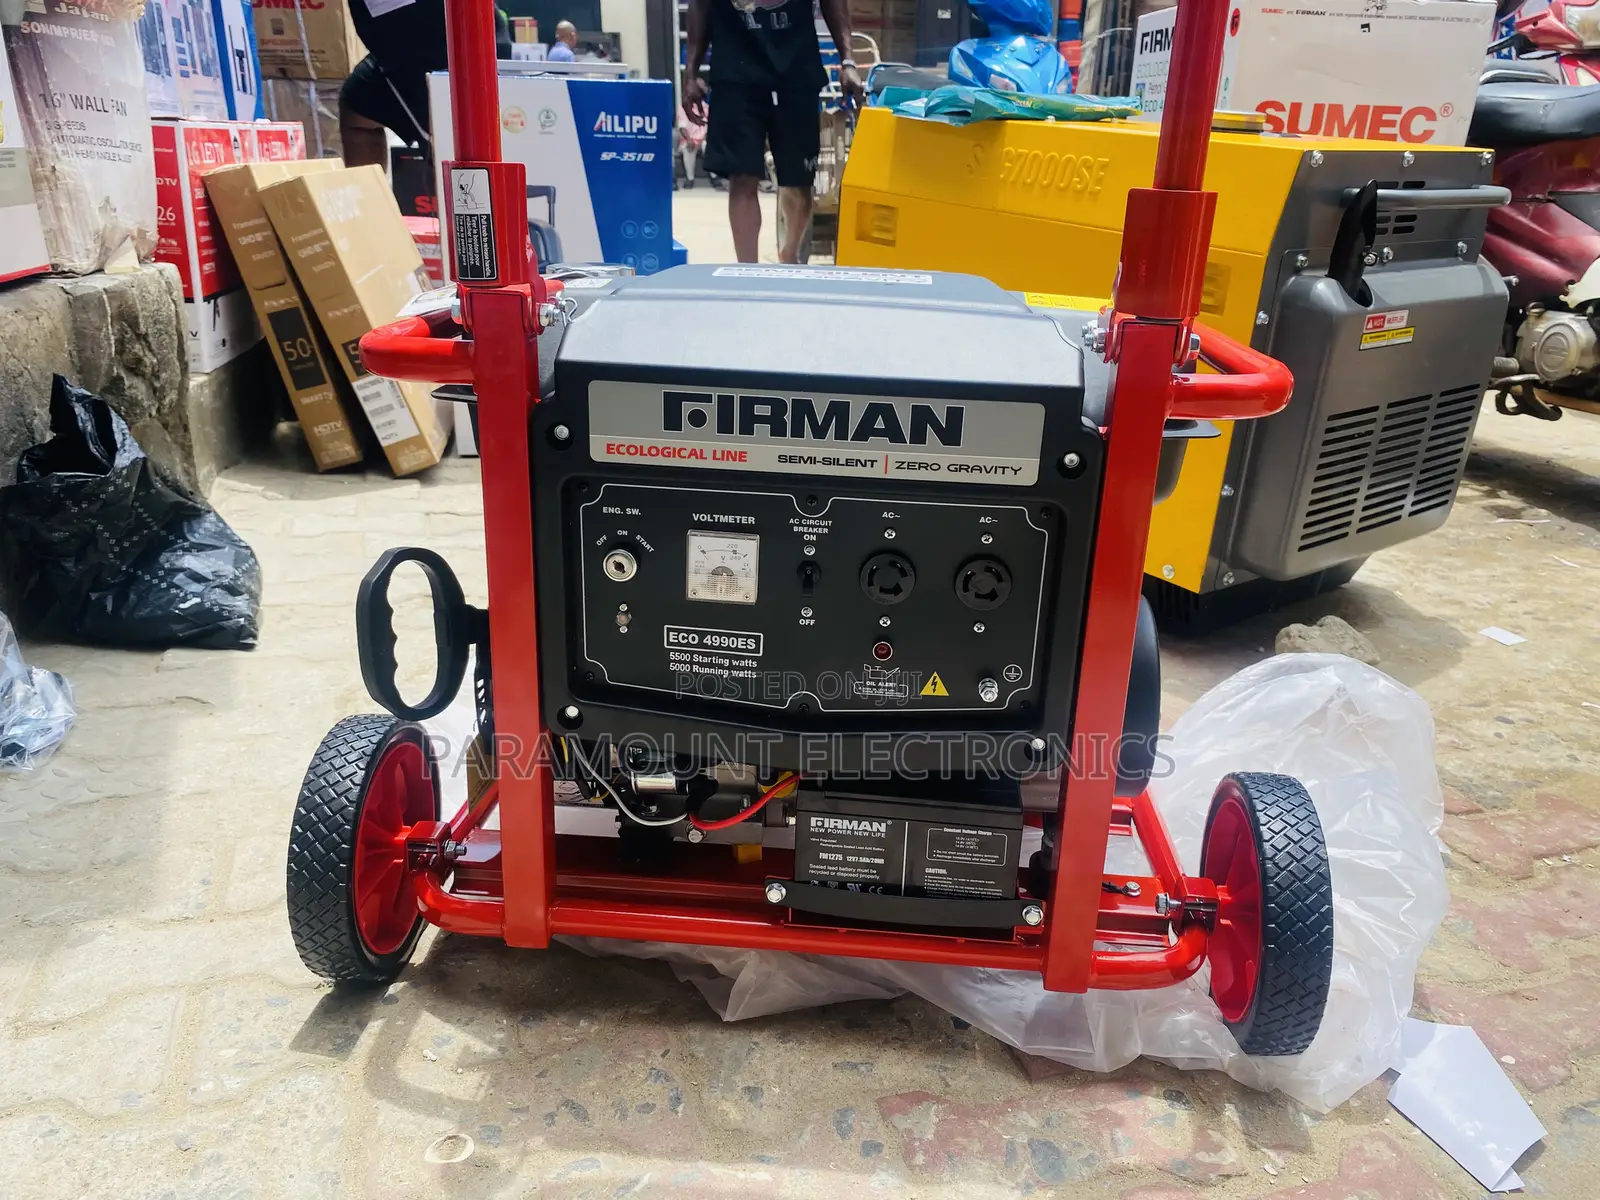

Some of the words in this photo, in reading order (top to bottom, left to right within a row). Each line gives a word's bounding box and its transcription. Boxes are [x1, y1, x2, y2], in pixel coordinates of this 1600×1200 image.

[69, 93, 109, 113] WALL
[593, 111, 658, 134] AILIPU
[283, 338, 310, 361] 50
[660, 388, 966, 449] FIRMAN
[606, 442, 708, 461] ECOLOGICAL
[712, 447, 748, 463] LINE
[777, 453, 878, 469] SEMI-SILENT
[895, 459, 941, 472] ZERO
[947, 463, 1024, 477] GRAVITY
[602, 506, 624, 515] ENG.
[626, 507, 641, 515] SW.
[692, 513, 756, 524] VOLTMETER
[793, 526, 829, 534] BREAKER
[801, 519, 833, 527] CIRCUIT
[596, 534, 609, 546] OFF
[635, 534, 655, 553] START
[799, 618, 816, 626] OFF
[669, 631, 699, 645] ECO
[703, 634, 756, 650] 4990ES
[669, 651, 691, 662] 5500
[693, 653, 730, 666] Starting
[731, 658, 758, 668] watts
[669, 662, 691, 672] 5000
[693, 664, 729, 678] Running
[731, 669, 757, 679] watts
[810, 816, 887, 832] FIRMAN
[819, 852, 843, 861] FM1275
